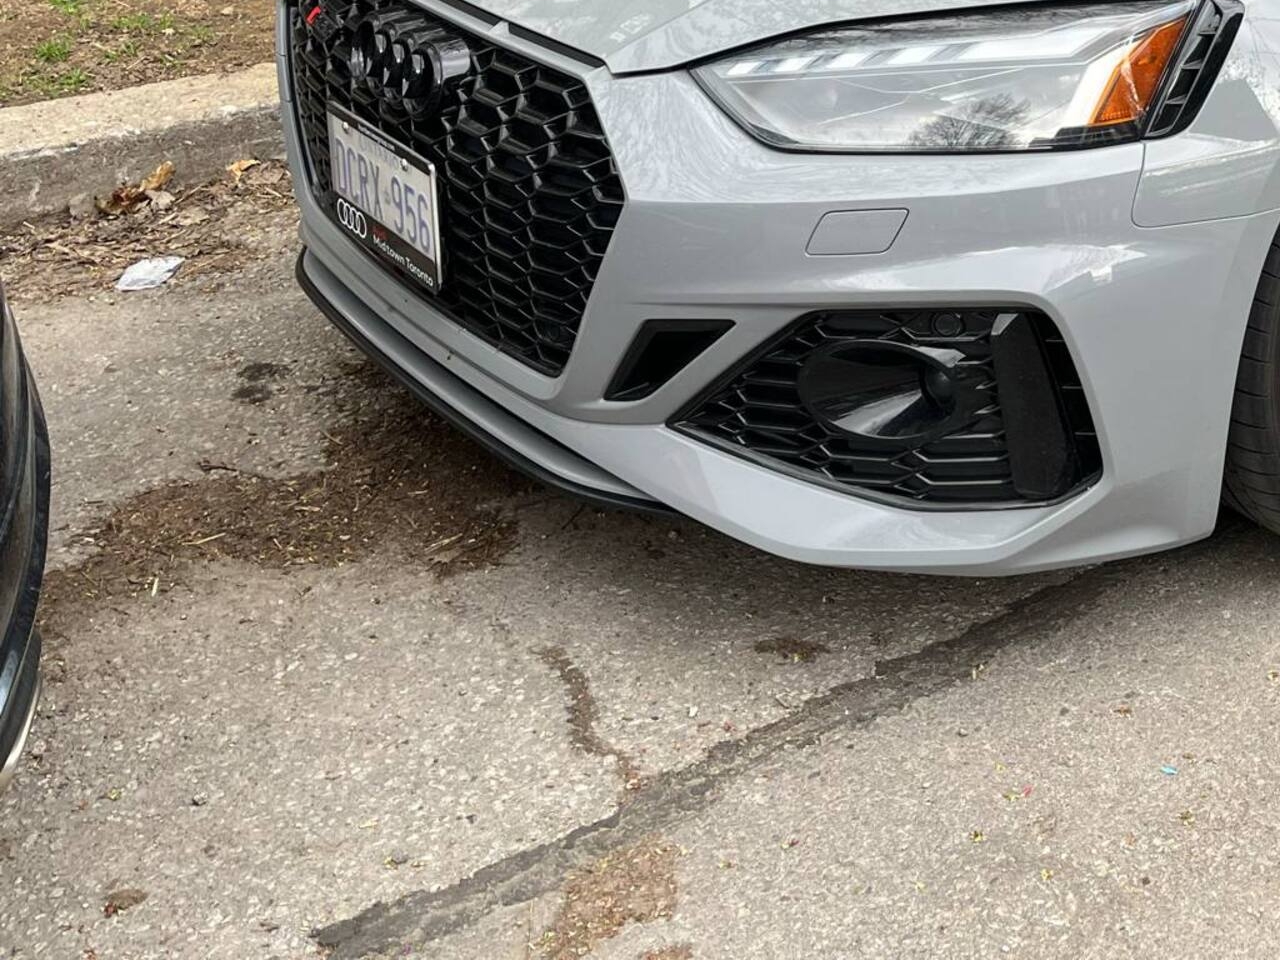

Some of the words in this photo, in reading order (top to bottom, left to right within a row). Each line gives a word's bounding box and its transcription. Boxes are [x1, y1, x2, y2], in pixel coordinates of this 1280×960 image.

[335, 138, 384, 221] DCRX
[391, 175, 430, 252] 956
[373, 233, 406, 266] Midtown
[405, 257, 434, 287] Toronto
